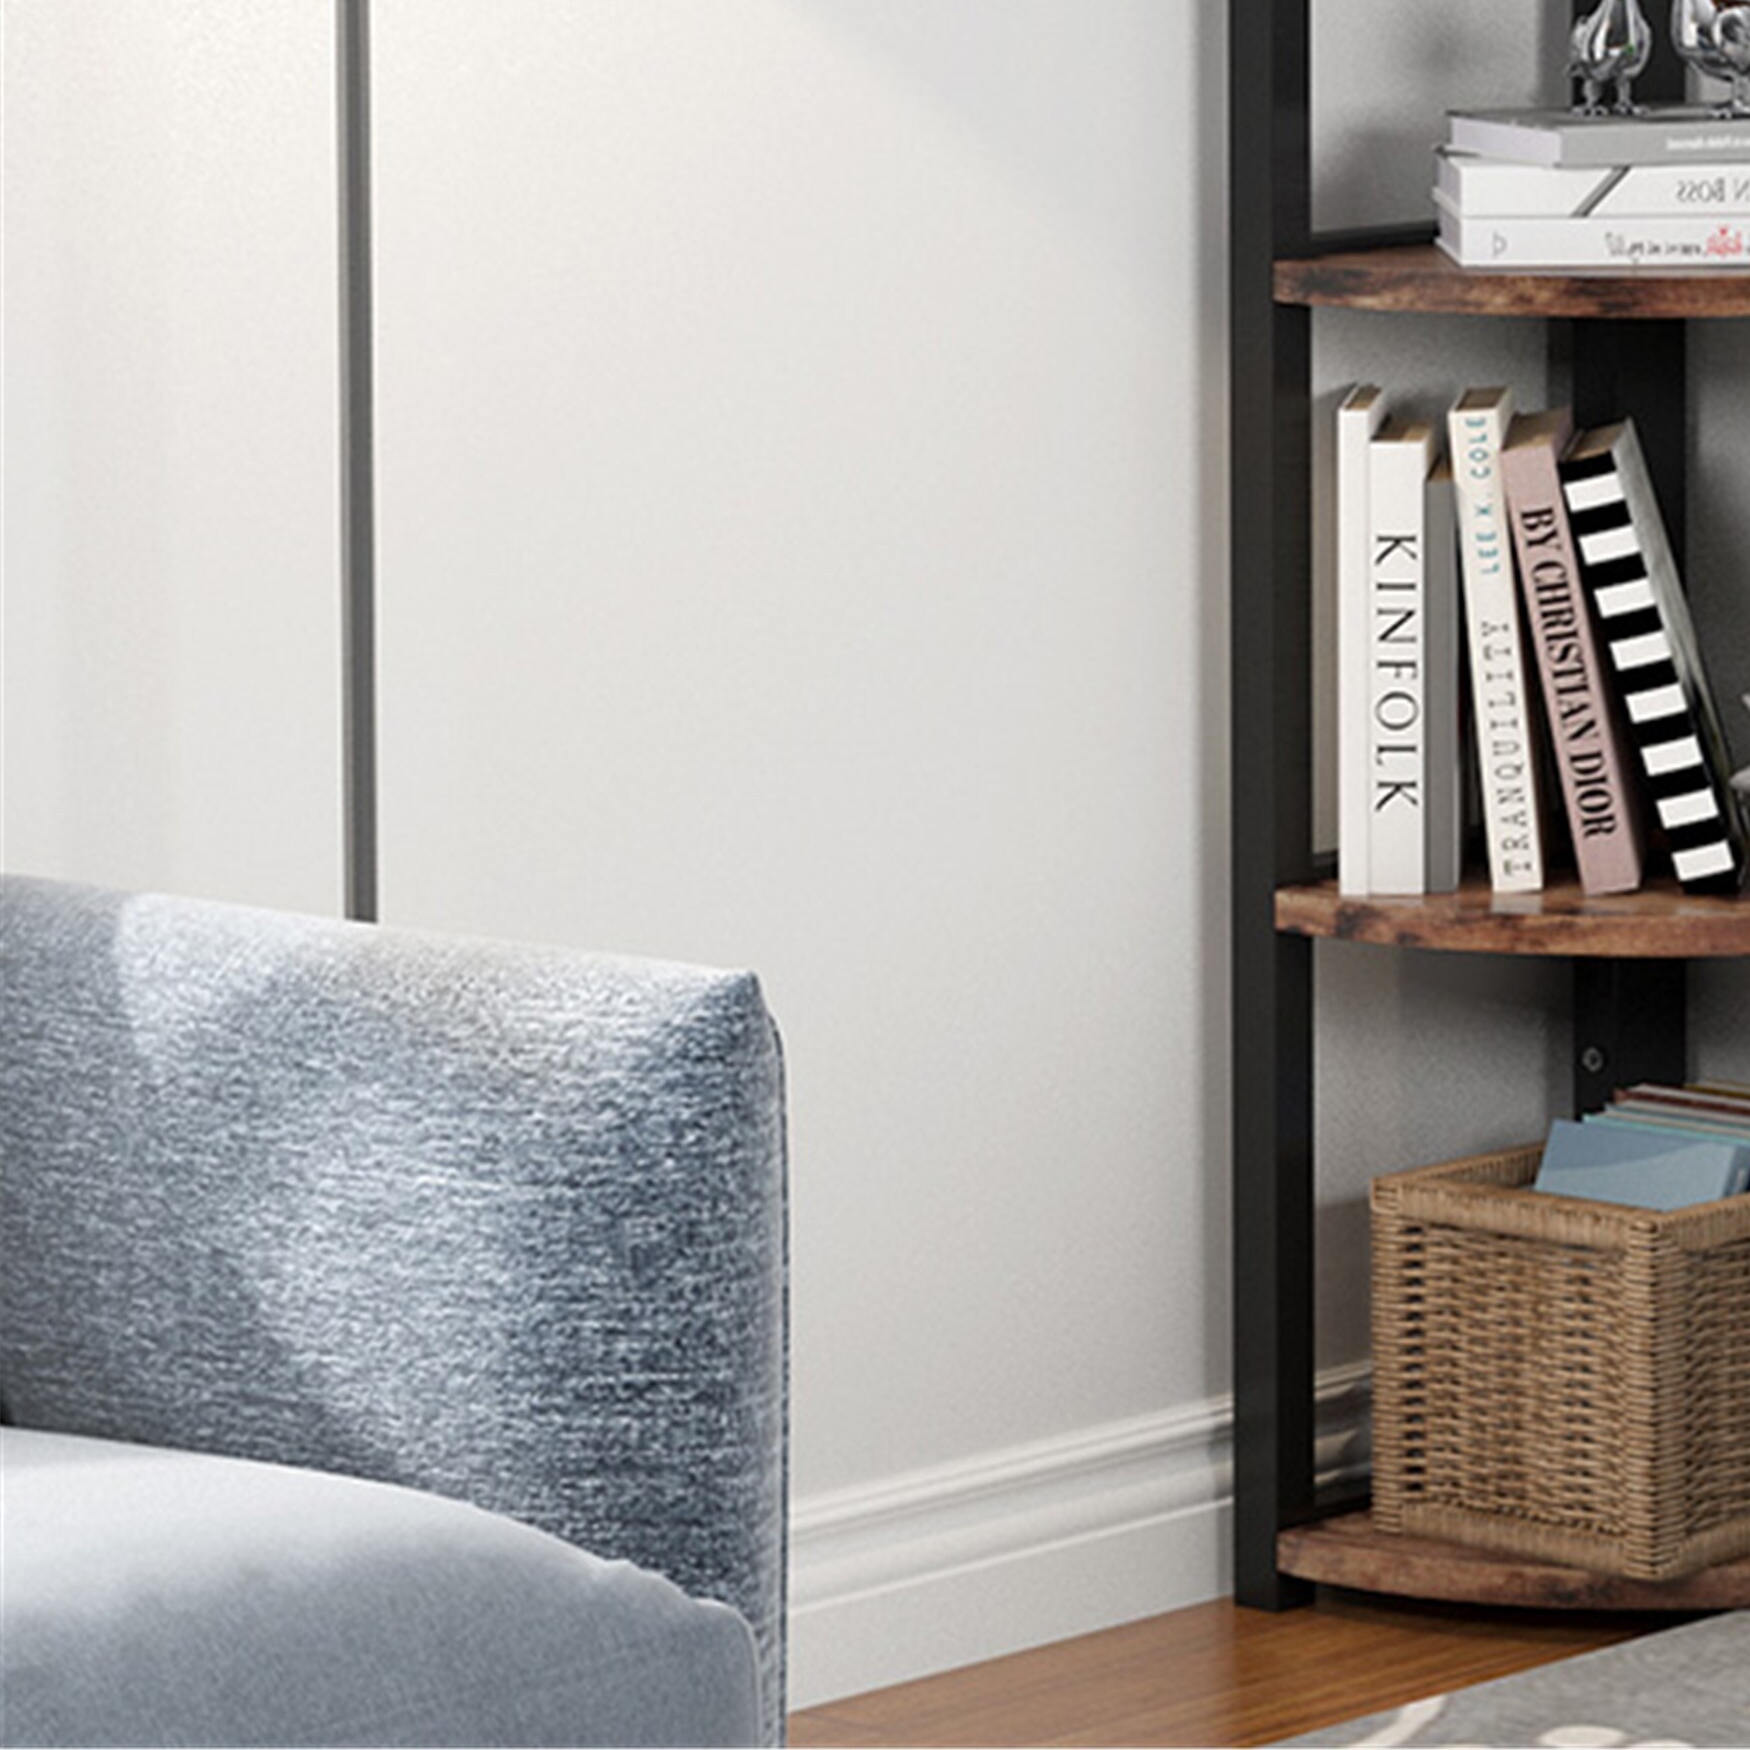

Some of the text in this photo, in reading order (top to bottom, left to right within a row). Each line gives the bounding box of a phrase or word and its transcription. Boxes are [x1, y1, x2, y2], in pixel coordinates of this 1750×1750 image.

[1465, 417, 1491, 478] COLE
[1475, 530, 1500, 575] LEE
[1375, 535, 1418, 812] KINFOLK
[1481, 620, 1532, 876] TRANQUILITY
[1520, 506, 1617, 838] BY CHRISTIAN DIOR
